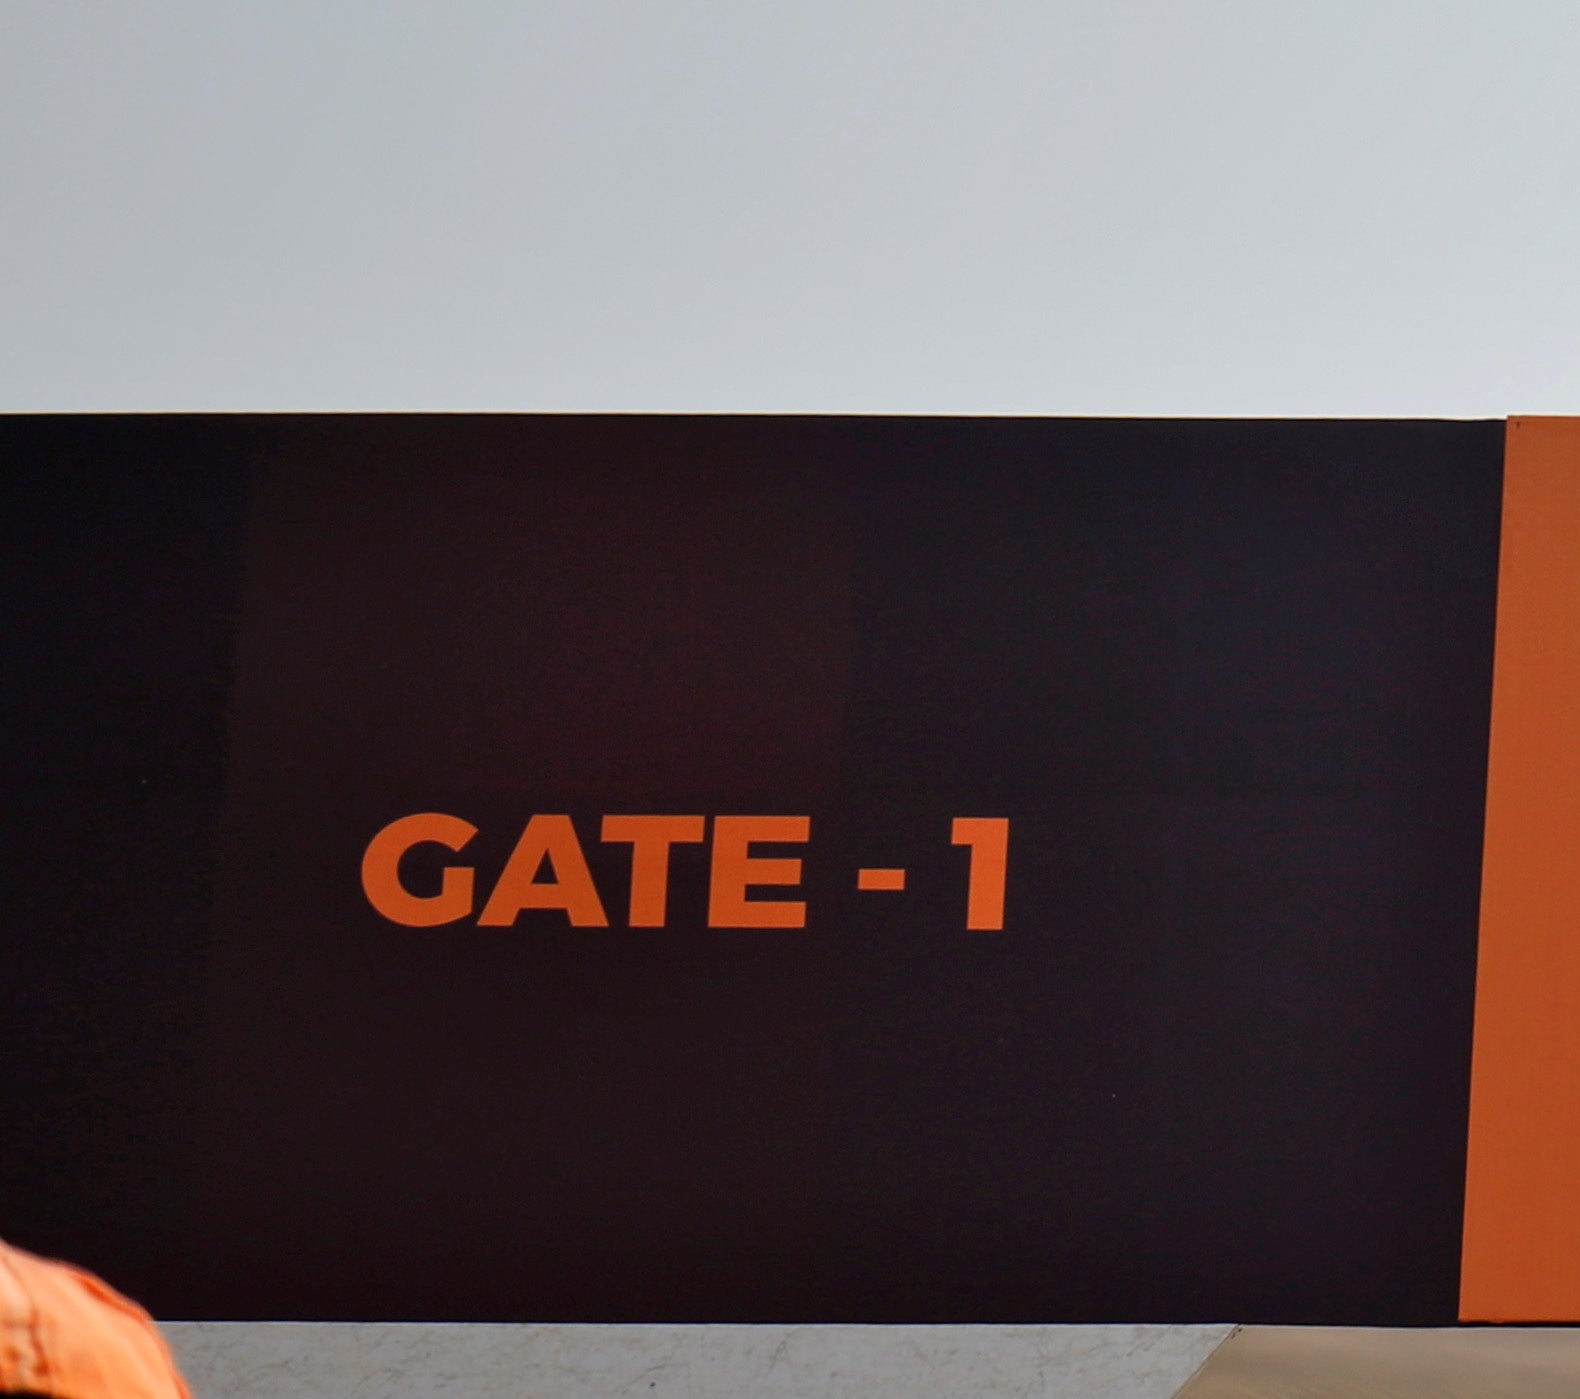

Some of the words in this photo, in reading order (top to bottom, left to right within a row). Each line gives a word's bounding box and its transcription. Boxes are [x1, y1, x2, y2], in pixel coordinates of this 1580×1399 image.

[360, 811, 811, 930] GATE
[857, 868, 906, 892] -
[950, 816, 1010, 932] 1
